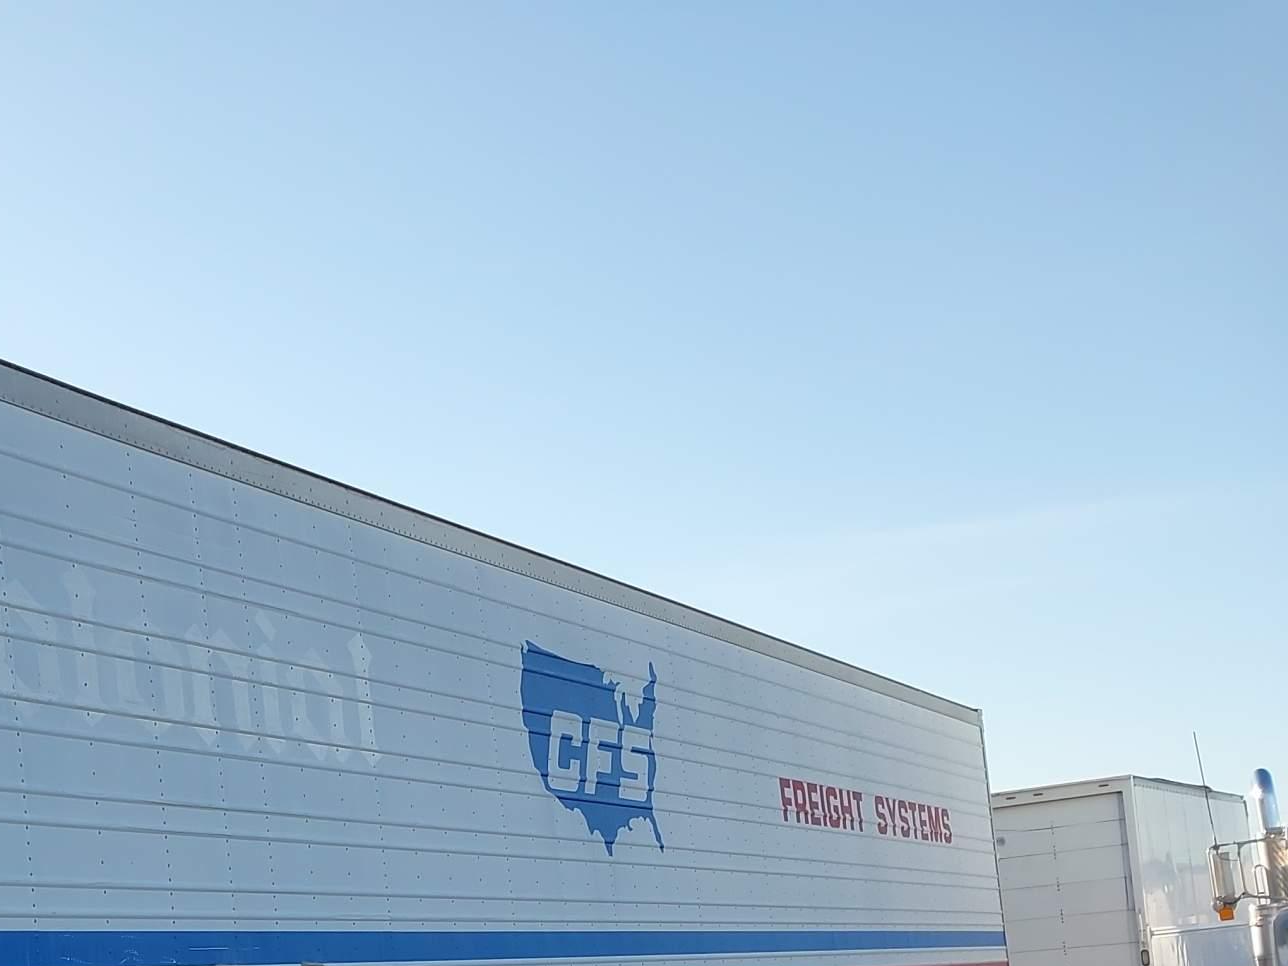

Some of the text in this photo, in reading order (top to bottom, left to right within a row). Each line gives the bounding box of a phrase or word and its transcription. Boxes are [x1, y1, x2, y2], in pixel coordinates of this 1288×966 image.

[548, 710, 652, 802] CFS
[779, 777, 953, 845] FREIGHT SYSTEMS
